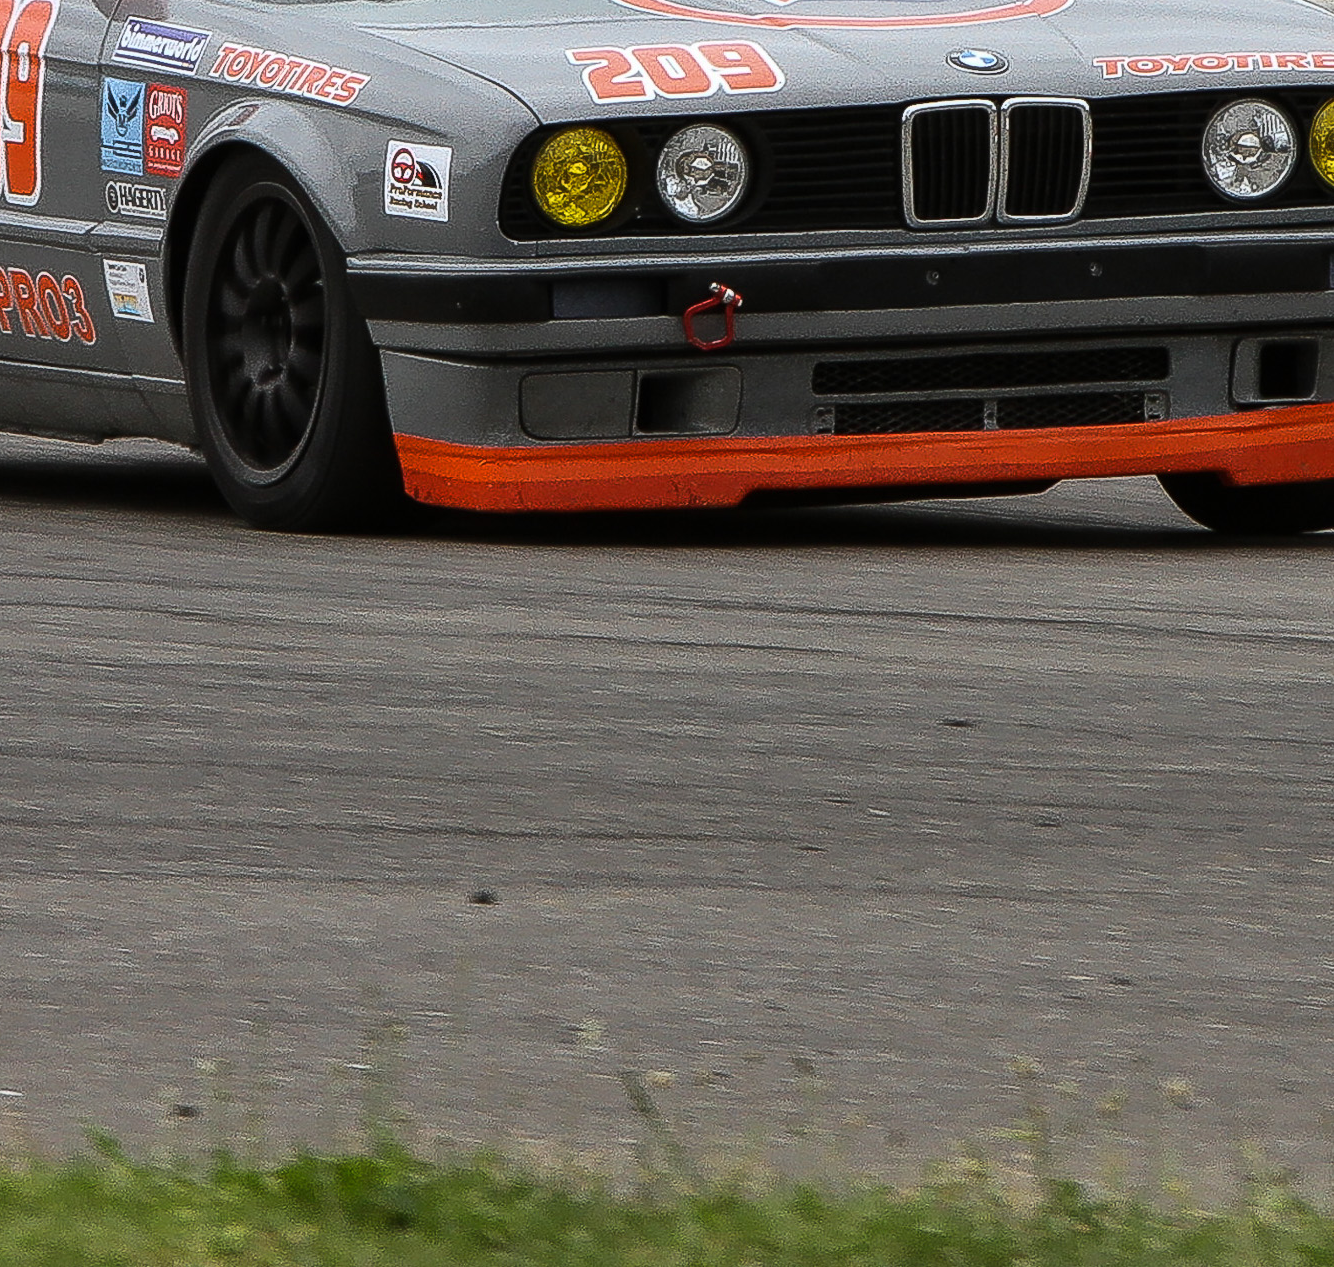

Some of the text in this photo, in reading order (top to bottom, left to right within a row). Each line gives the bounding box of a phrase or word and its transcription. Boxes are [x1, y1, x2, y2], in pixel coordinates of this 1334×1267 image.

[121, 23, 206, 61] bimmerworld
[566, 40, 785, 104] 209
[210, 43, 369, 105] TOYOTIRES
